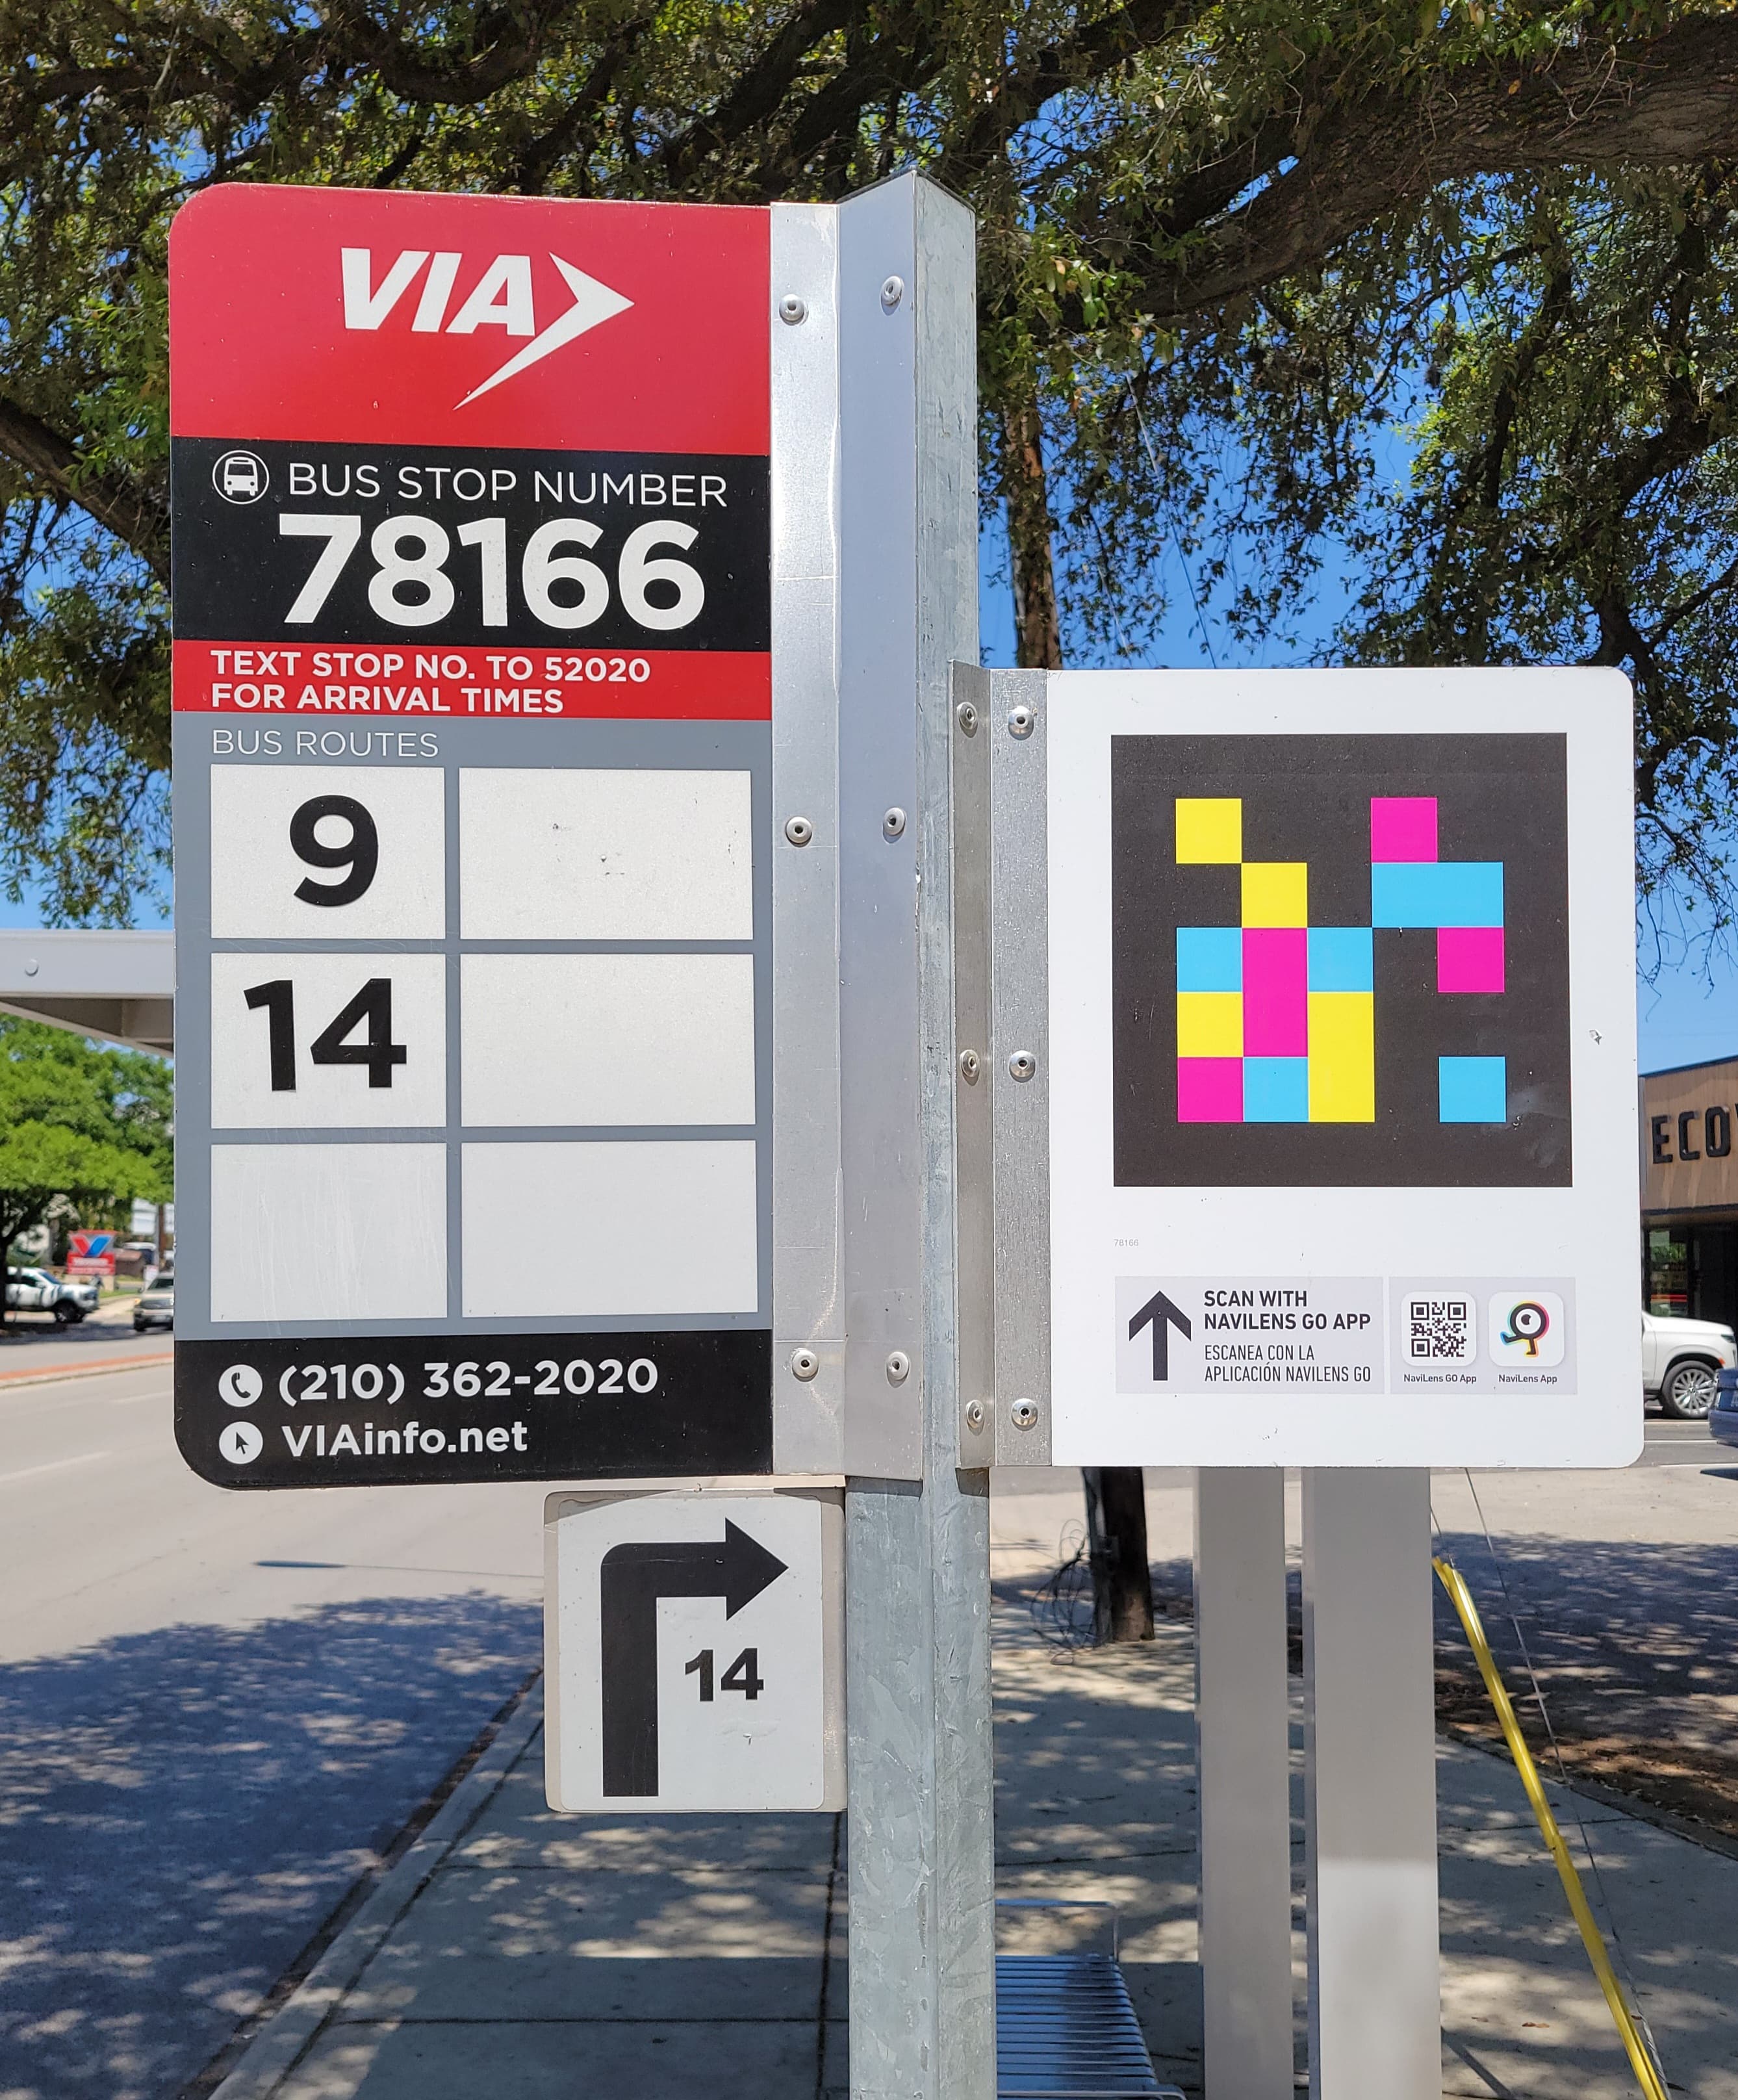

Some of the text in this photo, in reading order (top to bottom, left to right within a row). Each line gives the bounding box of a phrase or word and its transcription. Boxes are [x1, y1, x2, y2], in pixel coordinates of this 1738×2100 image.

[340, 246, 535, 337] VIA
[288, 462, 728, 508] BUS STOP NUMBER
[278, 512, 706, 631] 78166
[210, 650, 651, 683] TEXT STOP NO. TO 52020
[211, 682, 564, 714] FOR ARRIVAL TIMES
[212, 728, 439, 758] BUS ROUTES
[289, 795, 379, 908] 9
[243, 977, 407, 1092] 14
[1651, 1103, 1738, 1165] ECO
[1114, 1238, 1139, 1247] 78166
[1204, 1290, 1308, 1308] SCAN WITH
[1204, 1312, 1372, 1331] NAVILENS GO APP
[1204, 1344, 1316, 1361] ESCANEA CON LA
[278, 1357, 659, 1407] (210) 362-2020
[1204, 1362, 1372, 1383] APLICACIÓN NAVILENS GO
[1403, 1373, 1477, 1385] NaviLens GO App
[1498, 1374, 1558, 1385] NaviLens App
[281, 1420, 528, 1458] VIAinfo.net
[684, 1646, 765, 1702] 14
